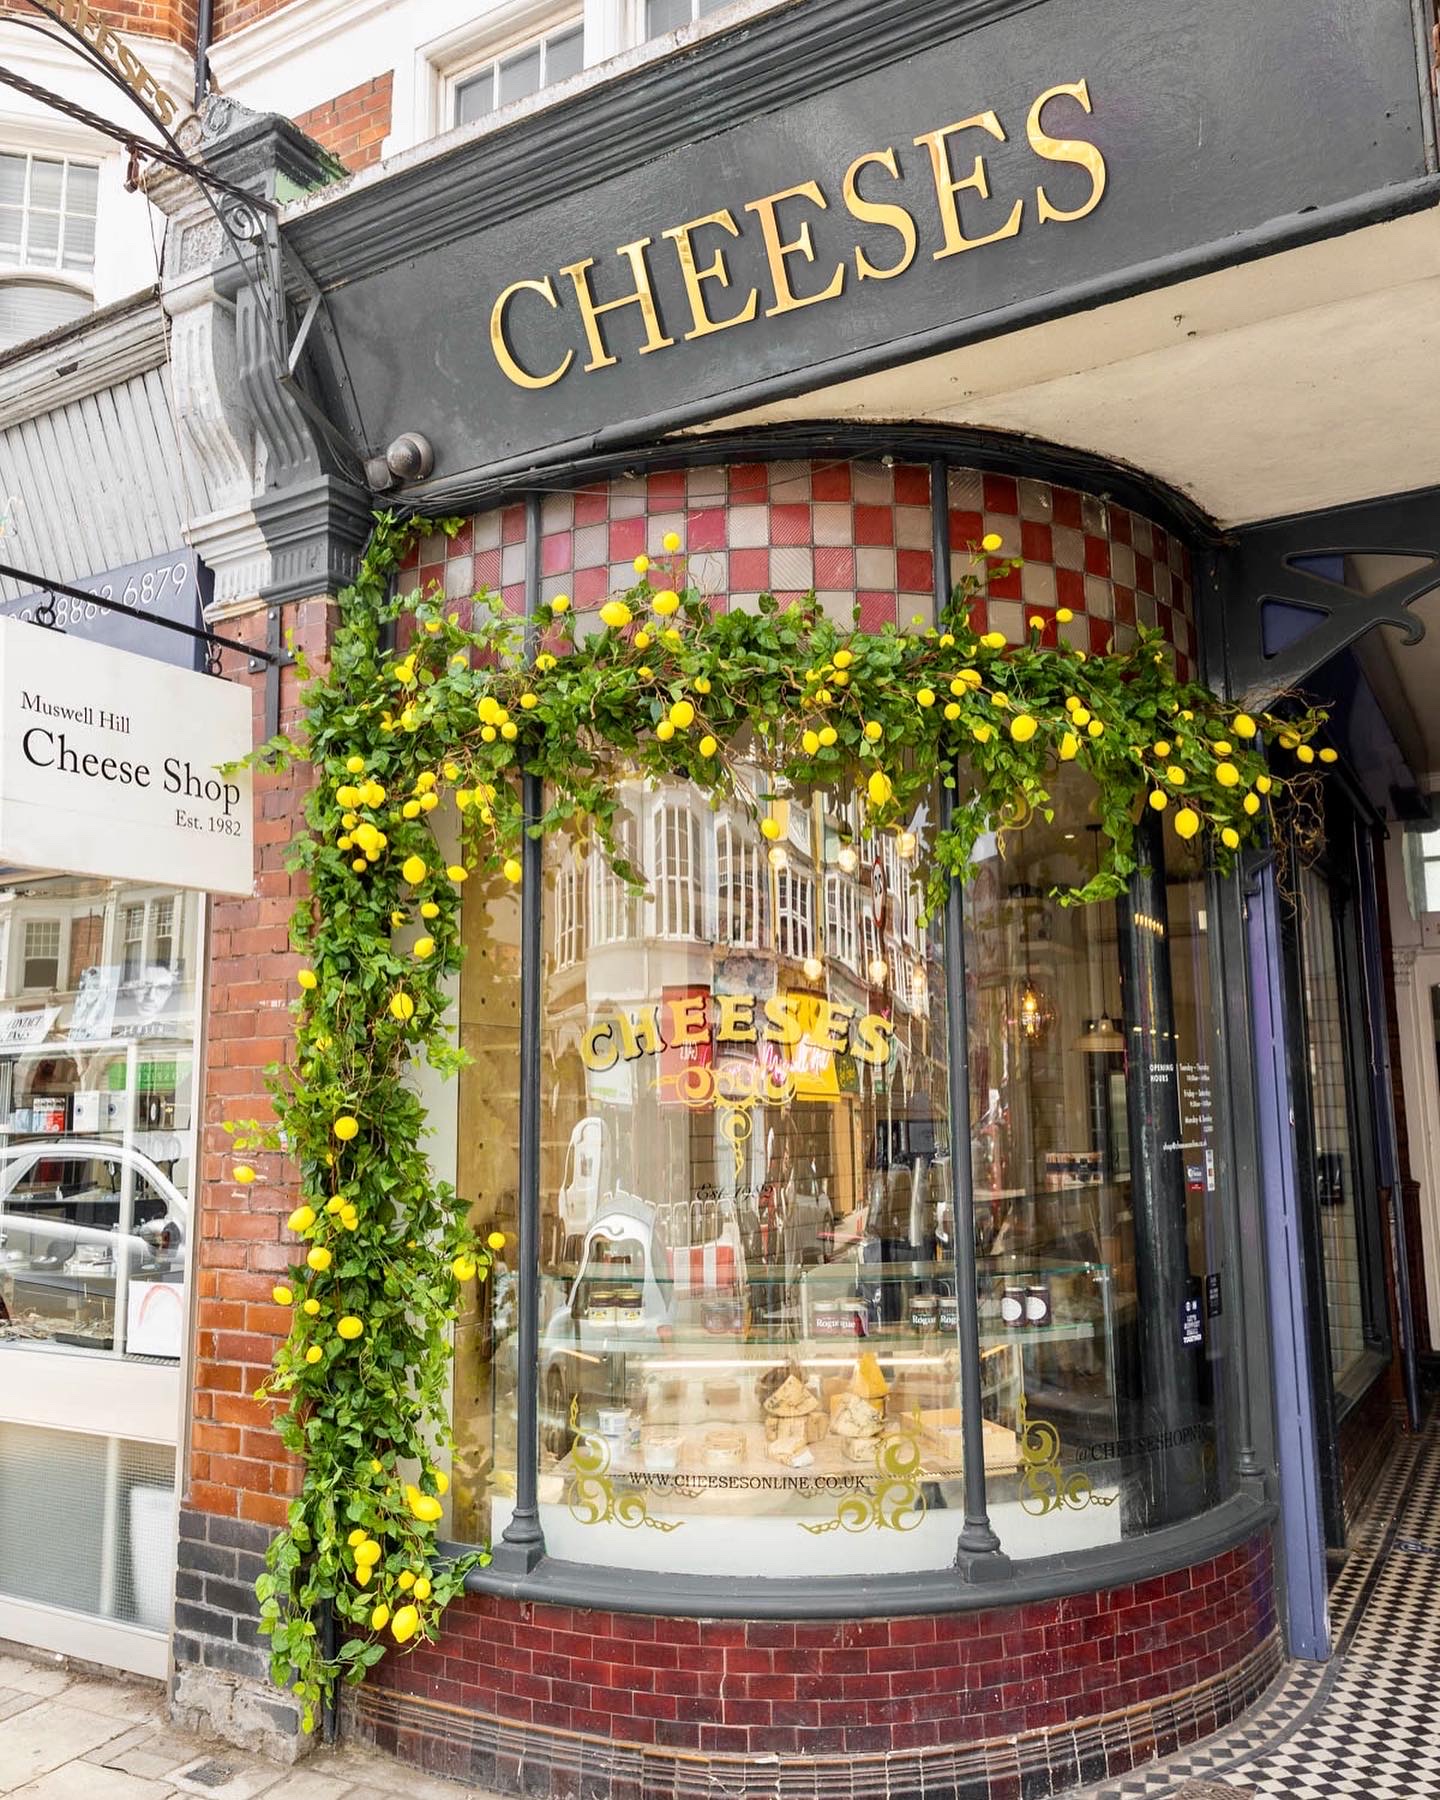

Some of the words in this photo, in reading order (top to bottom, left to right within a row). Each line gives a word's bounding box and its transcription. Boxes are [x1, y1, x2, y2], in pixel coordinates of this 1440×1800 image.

[488, 78, 1106, 389] CHEESES
[122, 562, 188, 608] 6879
[21, 691, 93, 725] Muswell
[99, 710, 131, 734] Hill
[23, 728, 151, 788] Cheese
[163, 758, 241, 816] Shop
[175, 809, 203, 830] Est.
[208, 816, 241, 837] 1982
[581, 995, 898, 1072] CHEESES
[1149, 1063, 1174, 1072] OPENING
[1150, 1074, 1169, 1082] HOURS
[629, 1471, 867, 1490] WWW.CHEESESONLINE.CO.UK
